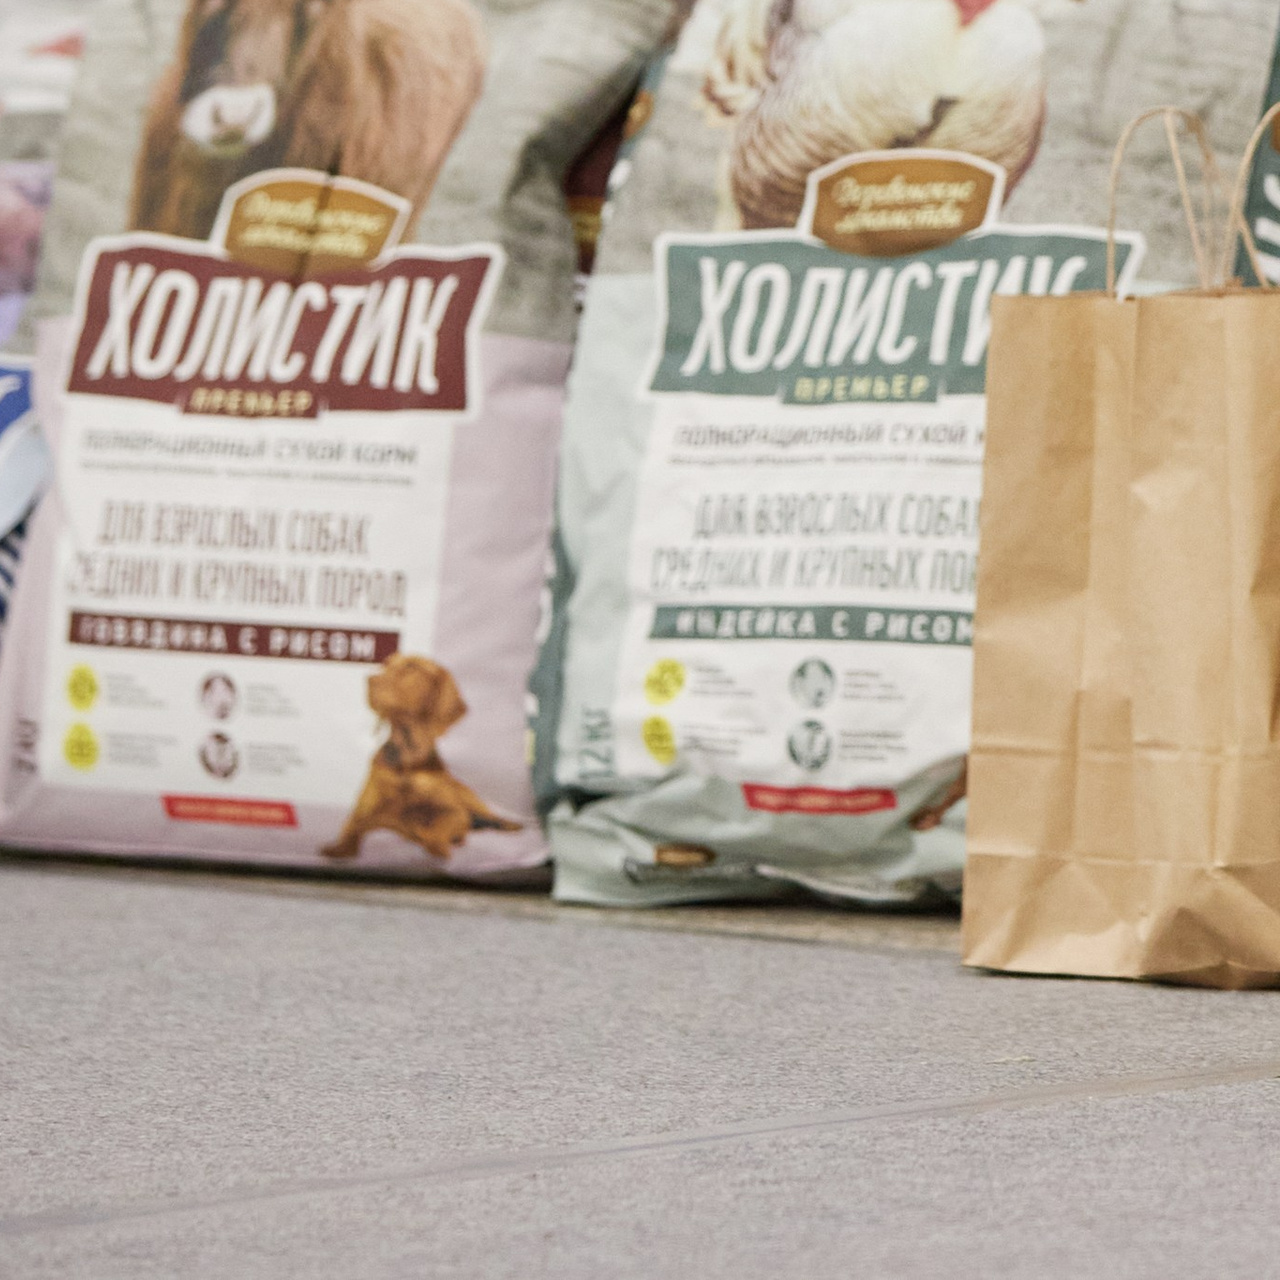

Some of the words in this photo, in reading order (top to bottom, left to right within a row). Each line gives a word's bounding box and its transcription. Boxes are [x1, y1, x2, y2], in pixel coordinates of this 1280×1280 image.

[85, 260, 459, 394] ХОЛИСТИК
[794, 375, 929, 401] ПРЕМЬЕР
[676, 609, 817, 638] ИНДЕЙКА
[830, 609, 850, 637] С
[238, 626, 258, 655] С
[268, 628, 376, 660] РИСОМ
